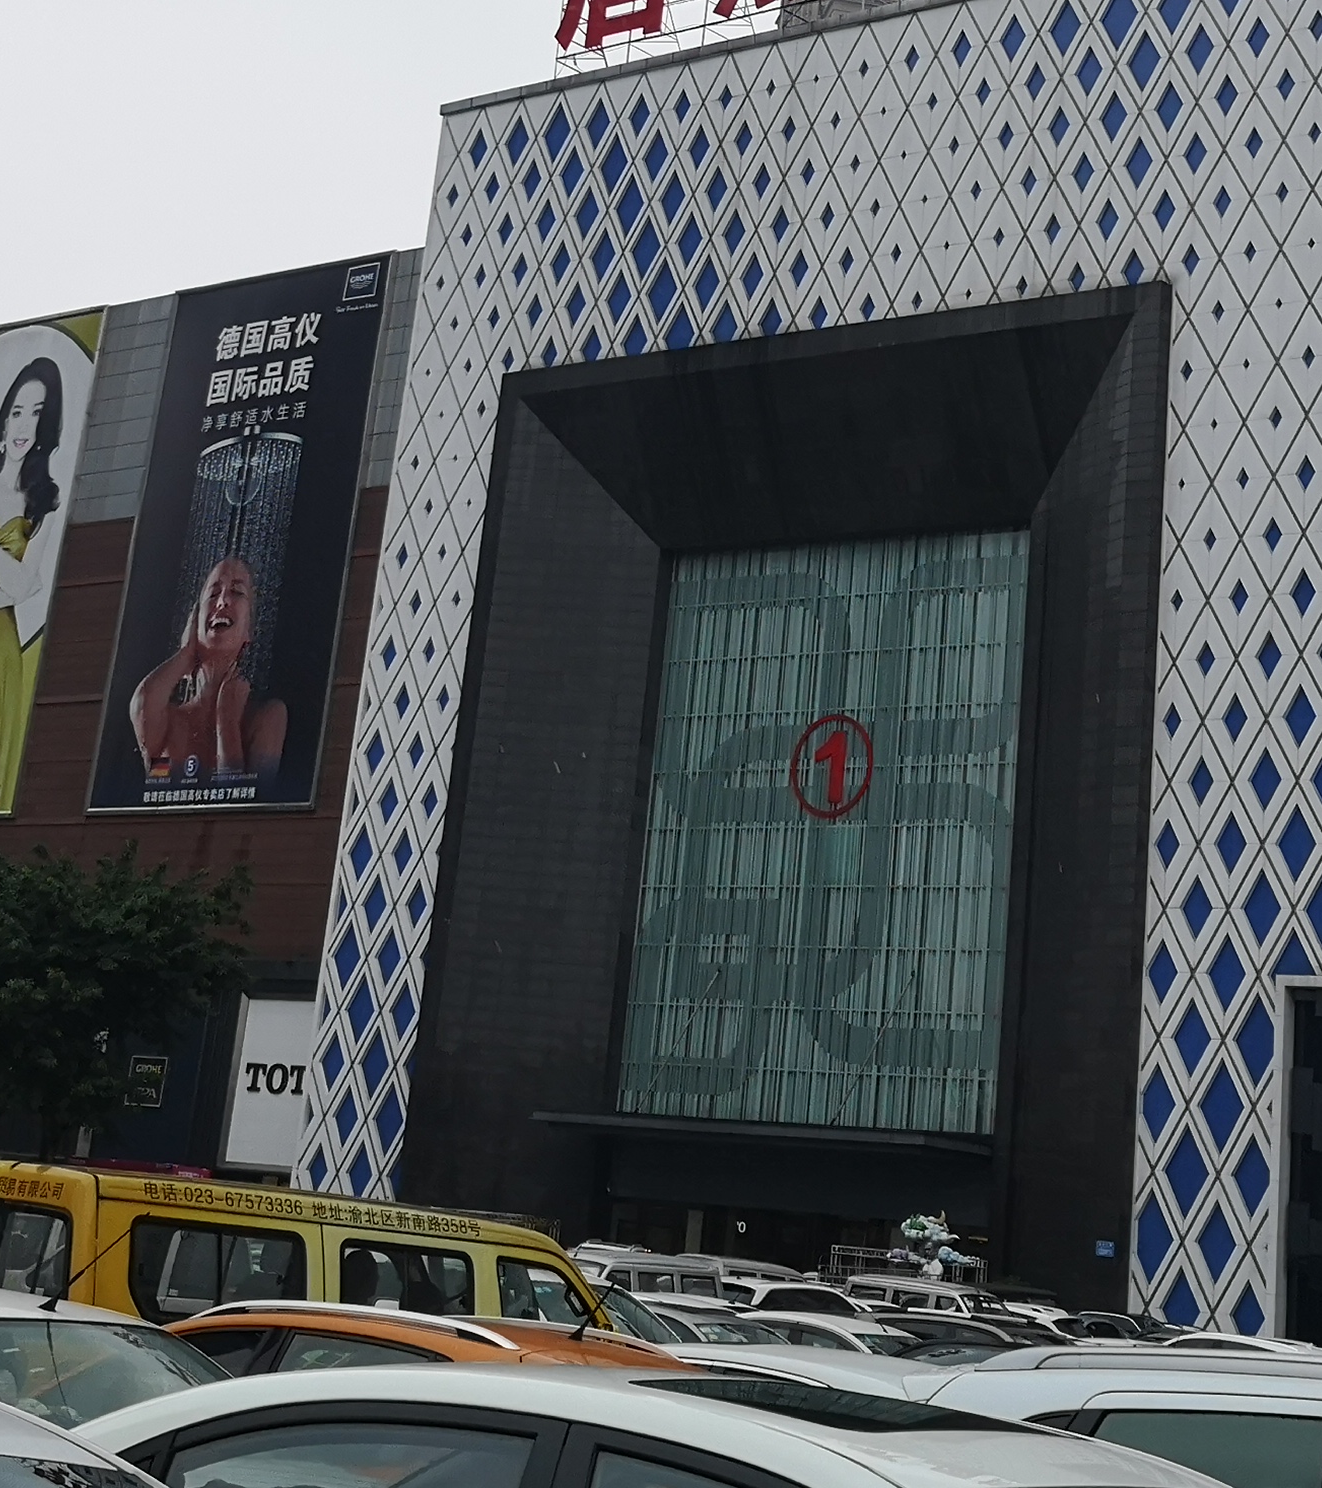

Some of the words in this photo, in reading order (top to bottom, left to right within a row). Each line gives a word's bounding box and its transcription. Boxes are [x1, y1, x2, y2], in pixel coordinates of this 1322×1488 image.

[216, 312, 322, 362] 德国高仪
[205, 355, 315, 407] 国际品质
[814, 730, 848, 804] 1
[143, 1180, 304, 1216] 电话:023-67573336
[311, 1201, 482, 1238] 地址:渝北区新南路358号
